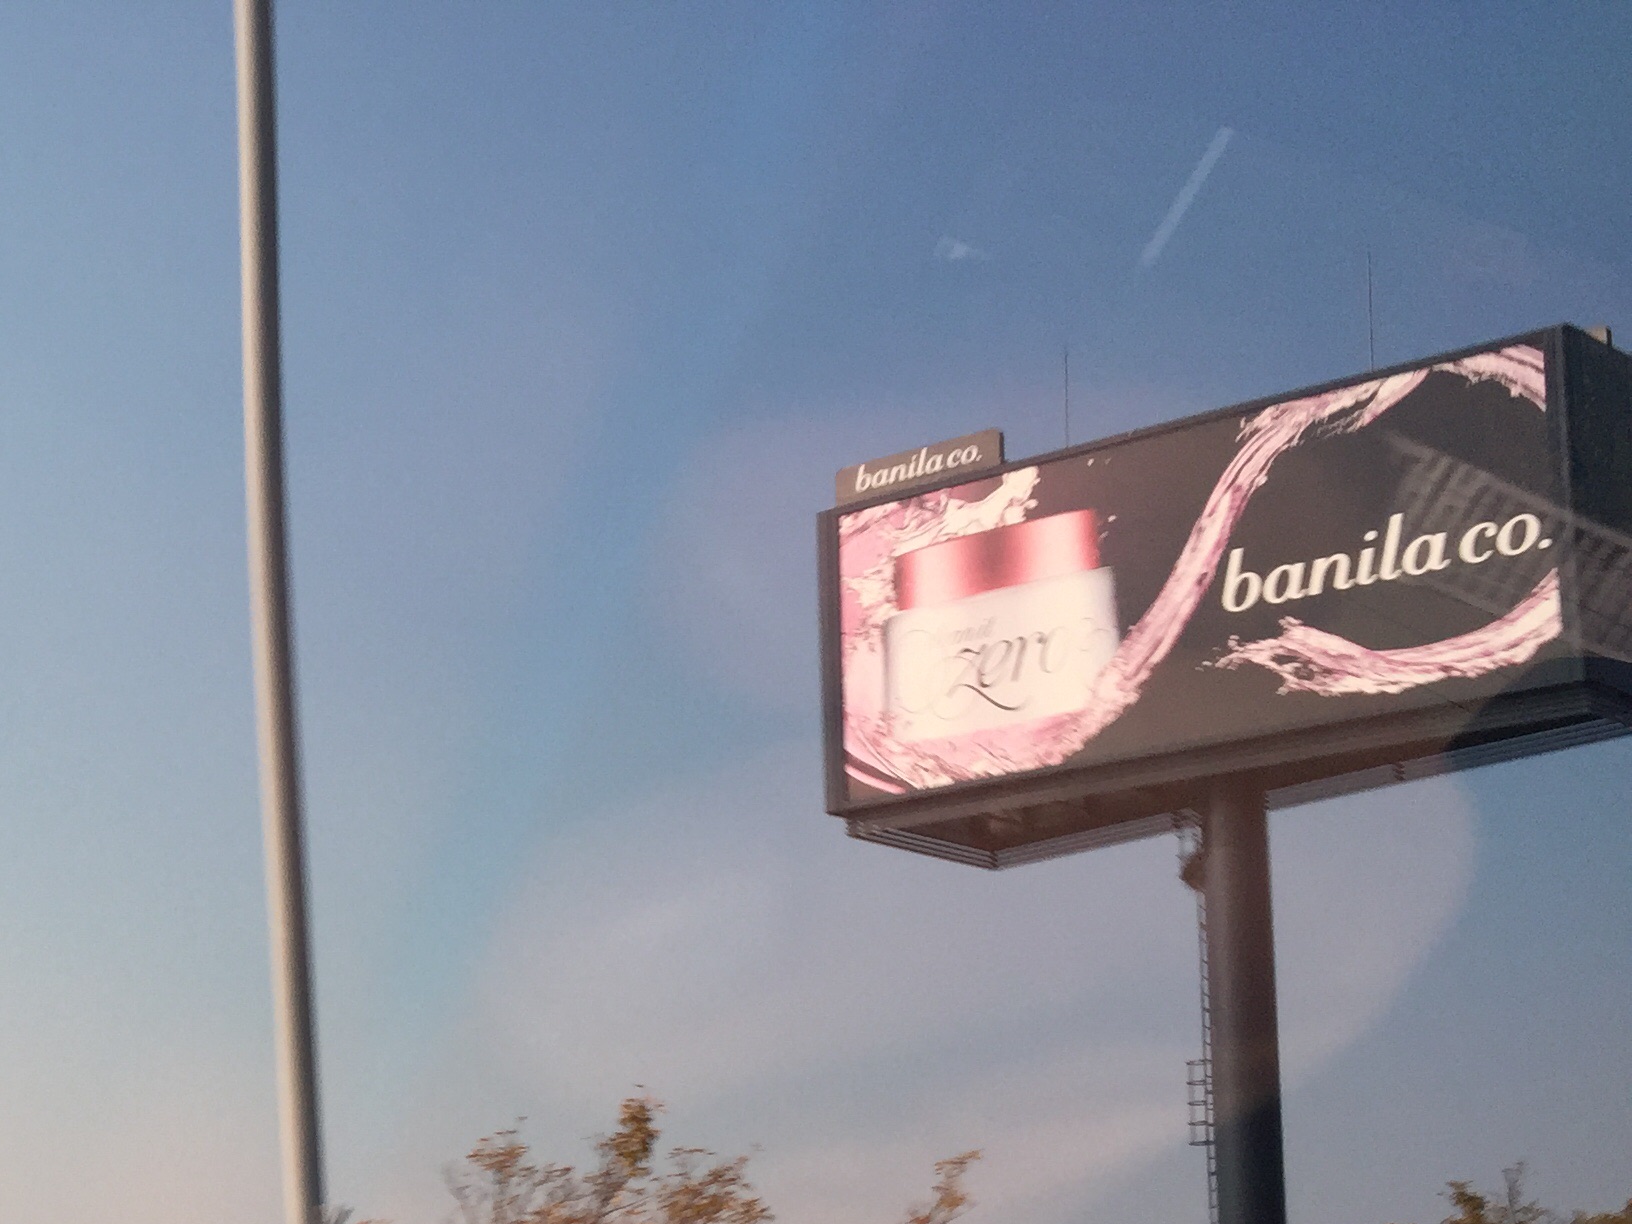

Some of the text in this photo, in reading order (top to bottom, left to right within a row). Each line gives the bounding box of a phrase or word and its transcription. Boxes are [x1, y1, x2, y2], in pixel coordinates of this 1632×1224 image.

[855, 444, 984, 493] banila co.
[1221, 512, 1554, 613] banila co.
